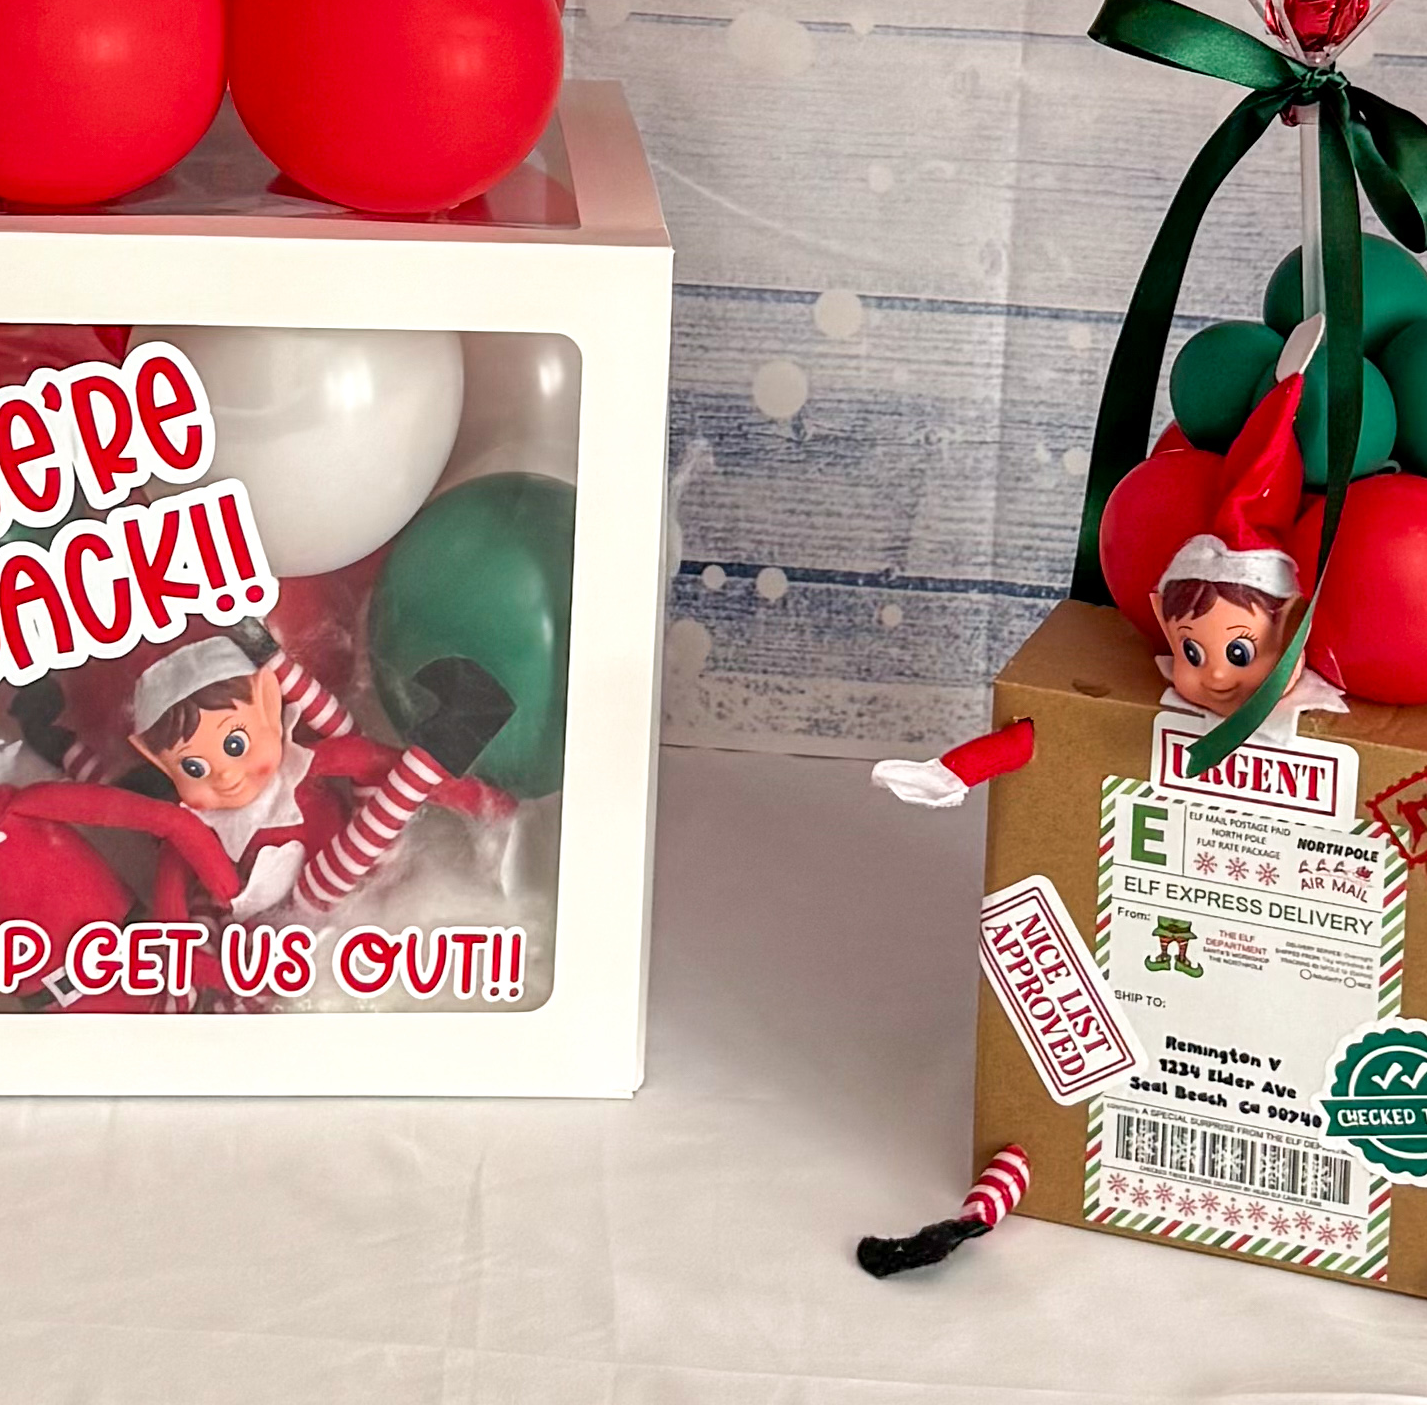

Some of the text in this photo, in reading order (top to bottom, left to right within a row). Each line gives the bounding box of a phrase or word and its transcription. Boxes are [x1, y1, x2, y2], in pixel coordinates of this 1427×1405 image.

[1130, 803, 1169, 866] E
[1189, 811, 1291, 837] ELF MAIL POSTAGE PAID
[1211, 828, 1266, 845] NORTH POLE
[1196, 837, 1281, 860] FLAT RATE PACKAGE
[1300, 877, 1369, 903] AIR MAIL
[1117, 906, 1151, 922] From:
[1124, 876, 1374, 936] ELF EXPRESS DELIVERY
[1219, 929, 1255, 943] THE ELF
[72, 927, 204, 992] GET
[227, 930, 312, 993] US
[339, 929, 524, 999] OUT!!
[1016, 913, 1112, 1054] NICE LIST
[985, 923, 1086, 1076] APPROVED
[1114, 989, 1166, 1008] SHIP TO:
[1165, 1035, 1282, 1072] Remington V
[1159, 1058, 1200, 1079] 1234
[1207, 1069, 1255, 1090] Elder
[1129, 1075, 1168, 1096] Seal
[1174, 1085, 1228, 1108] Beach
[1267, 1106, 1323, 1129] 90740
[1337, 1107, 1416, 1128] CHECKED
